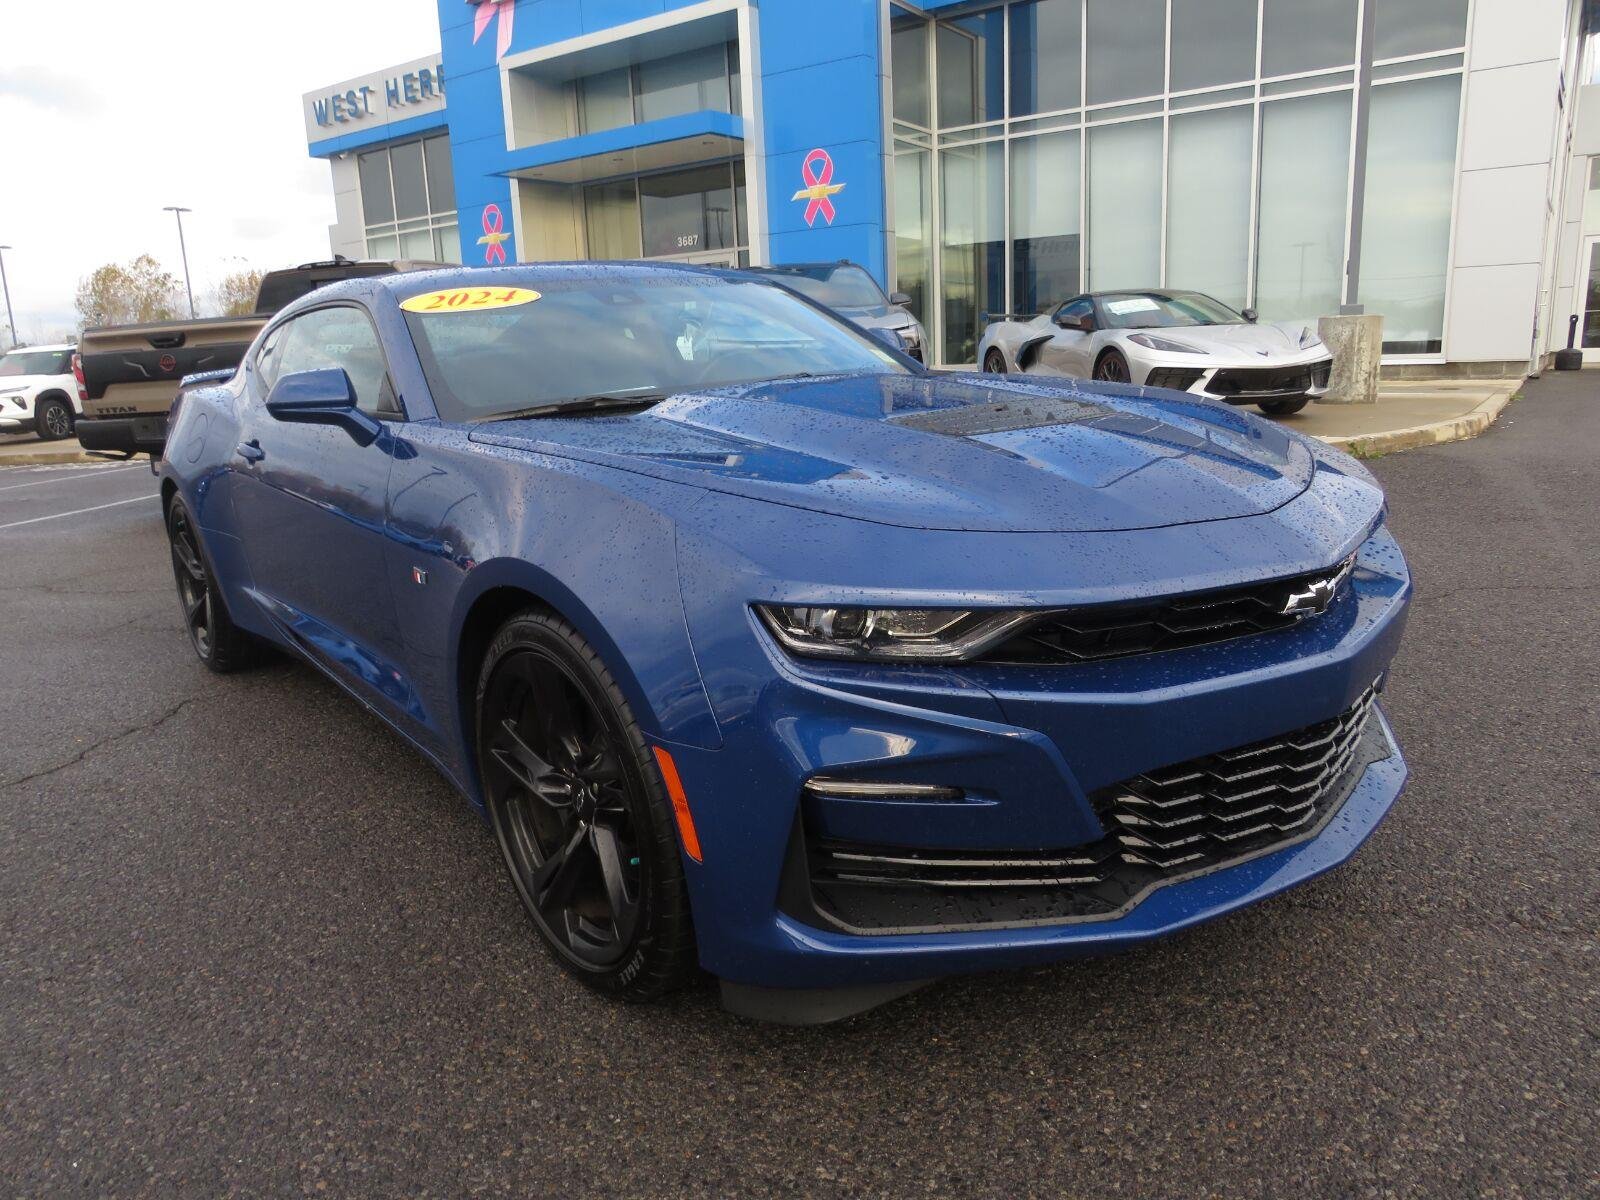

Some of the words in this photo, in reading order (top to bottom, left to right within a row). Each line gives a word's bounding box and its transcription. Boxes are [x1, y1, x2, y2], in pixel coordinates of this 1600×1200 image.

[312, 85, 371, 126] WEST
[676, 234, 698, 247] 3687
[424, 290, 517, 310] 2024
[97, 406, 138, 414] TITAN
